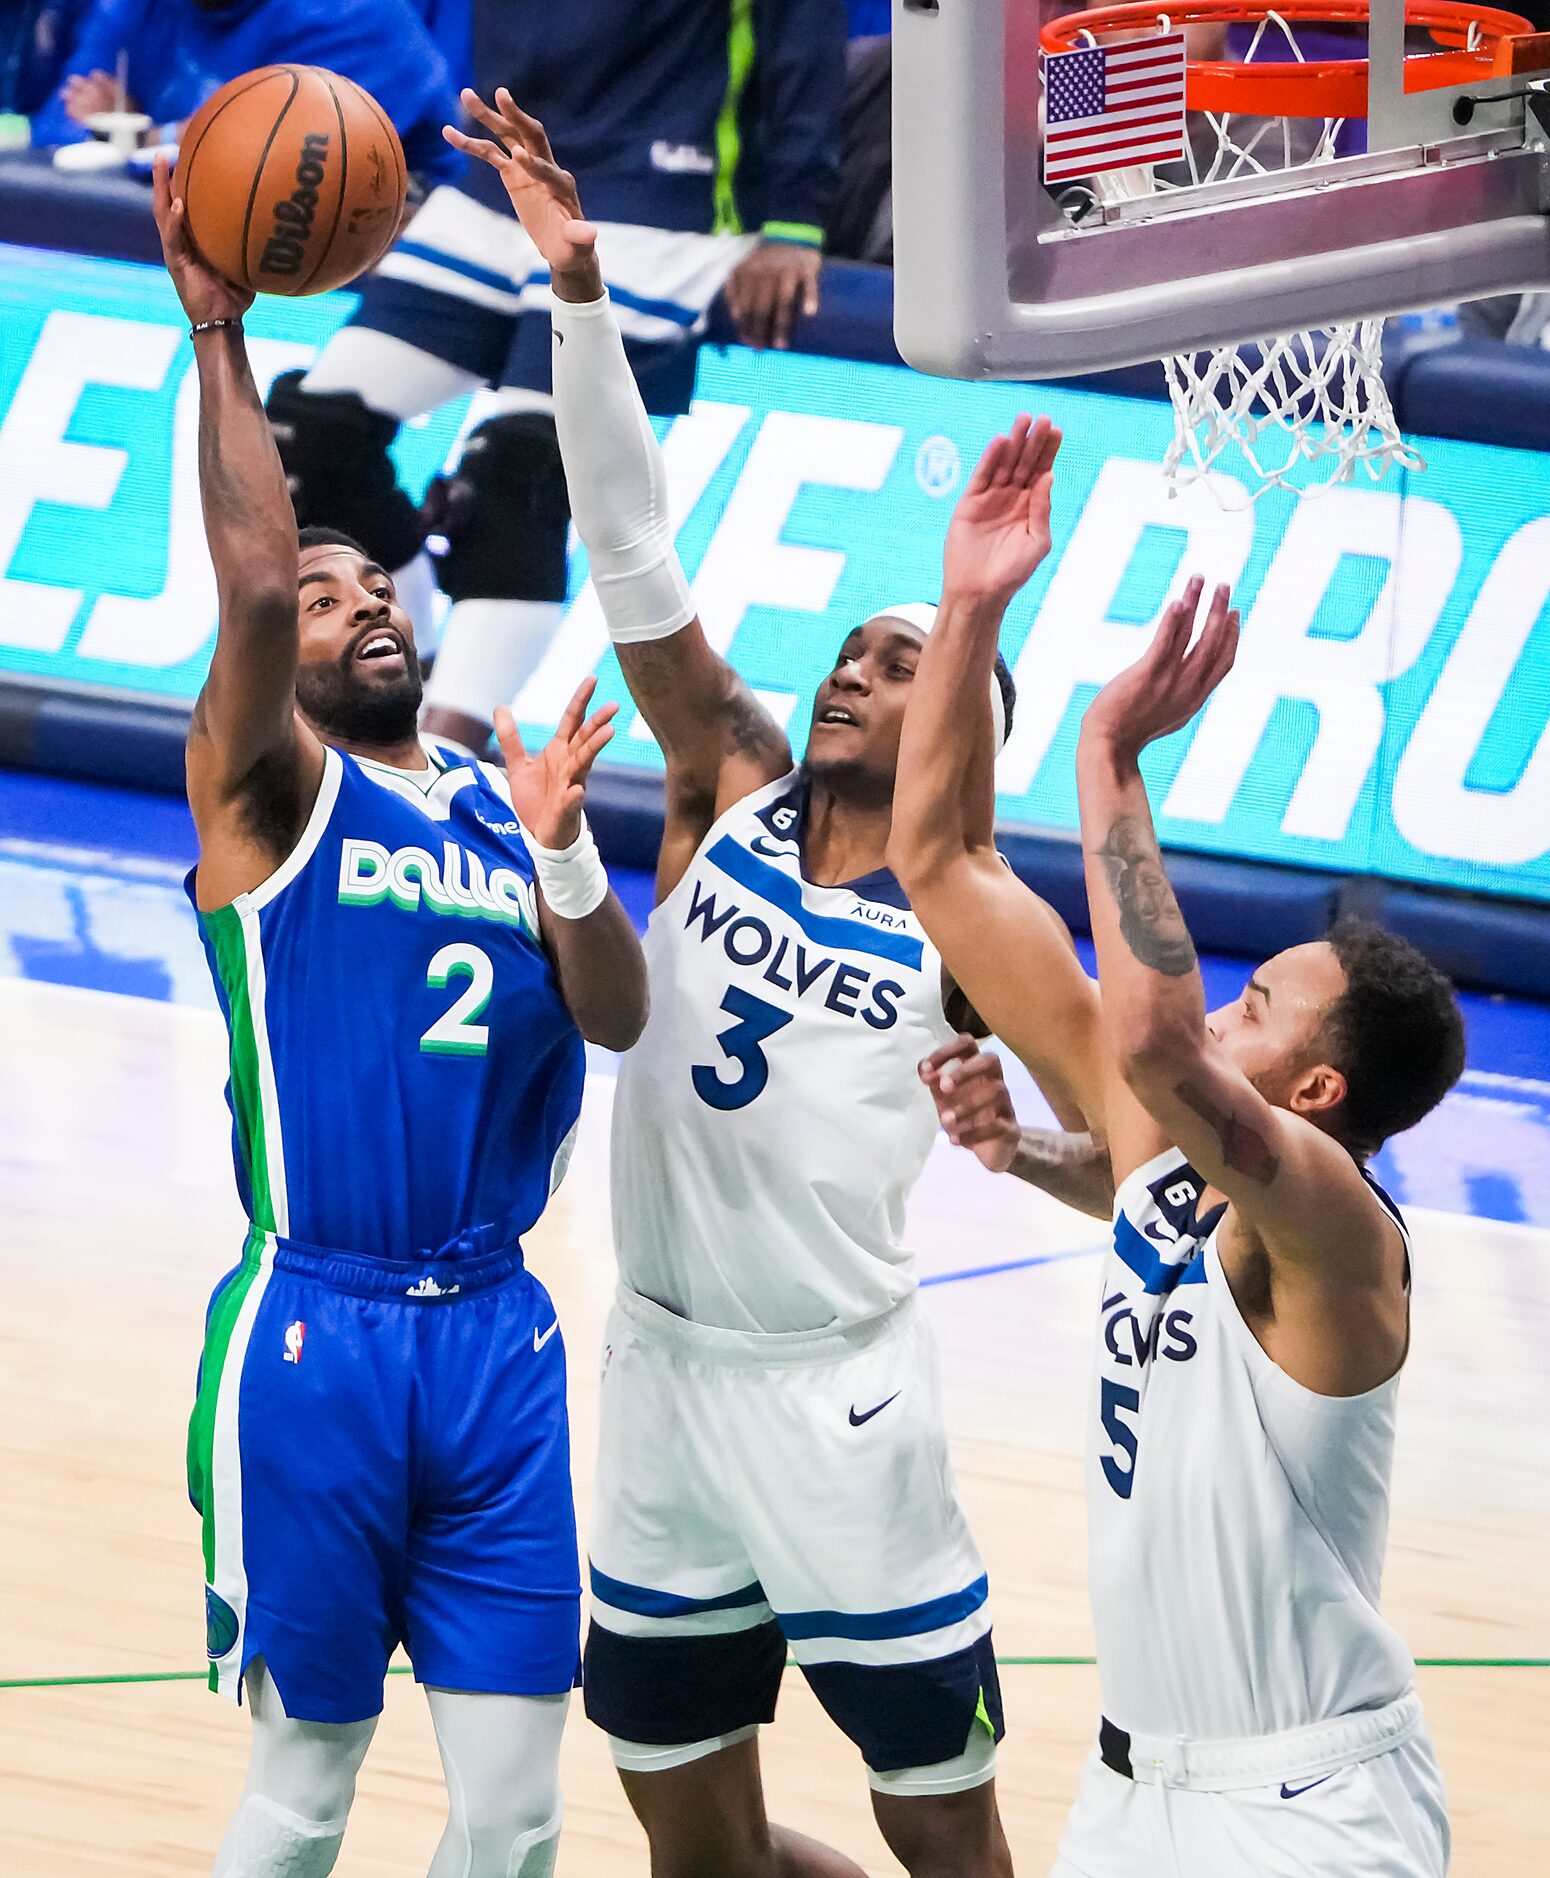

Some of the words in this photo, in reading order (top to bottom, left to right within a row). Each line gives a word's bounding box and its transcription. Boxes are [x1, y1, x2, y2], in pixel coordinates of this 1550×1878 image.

[259, 132, 328, 275] Wilson
[772, 808, 798, 830] 6
[338, 838, 540, 944] Dalla
[420, 942, 494, 1056] 2
[684, 879, 906, 1030] WOLVES
[691, 984, 795, 1112] 3
[1164, 1179, 1197, 1207] 6
[1100, 1376, 1140, 1499] 5
